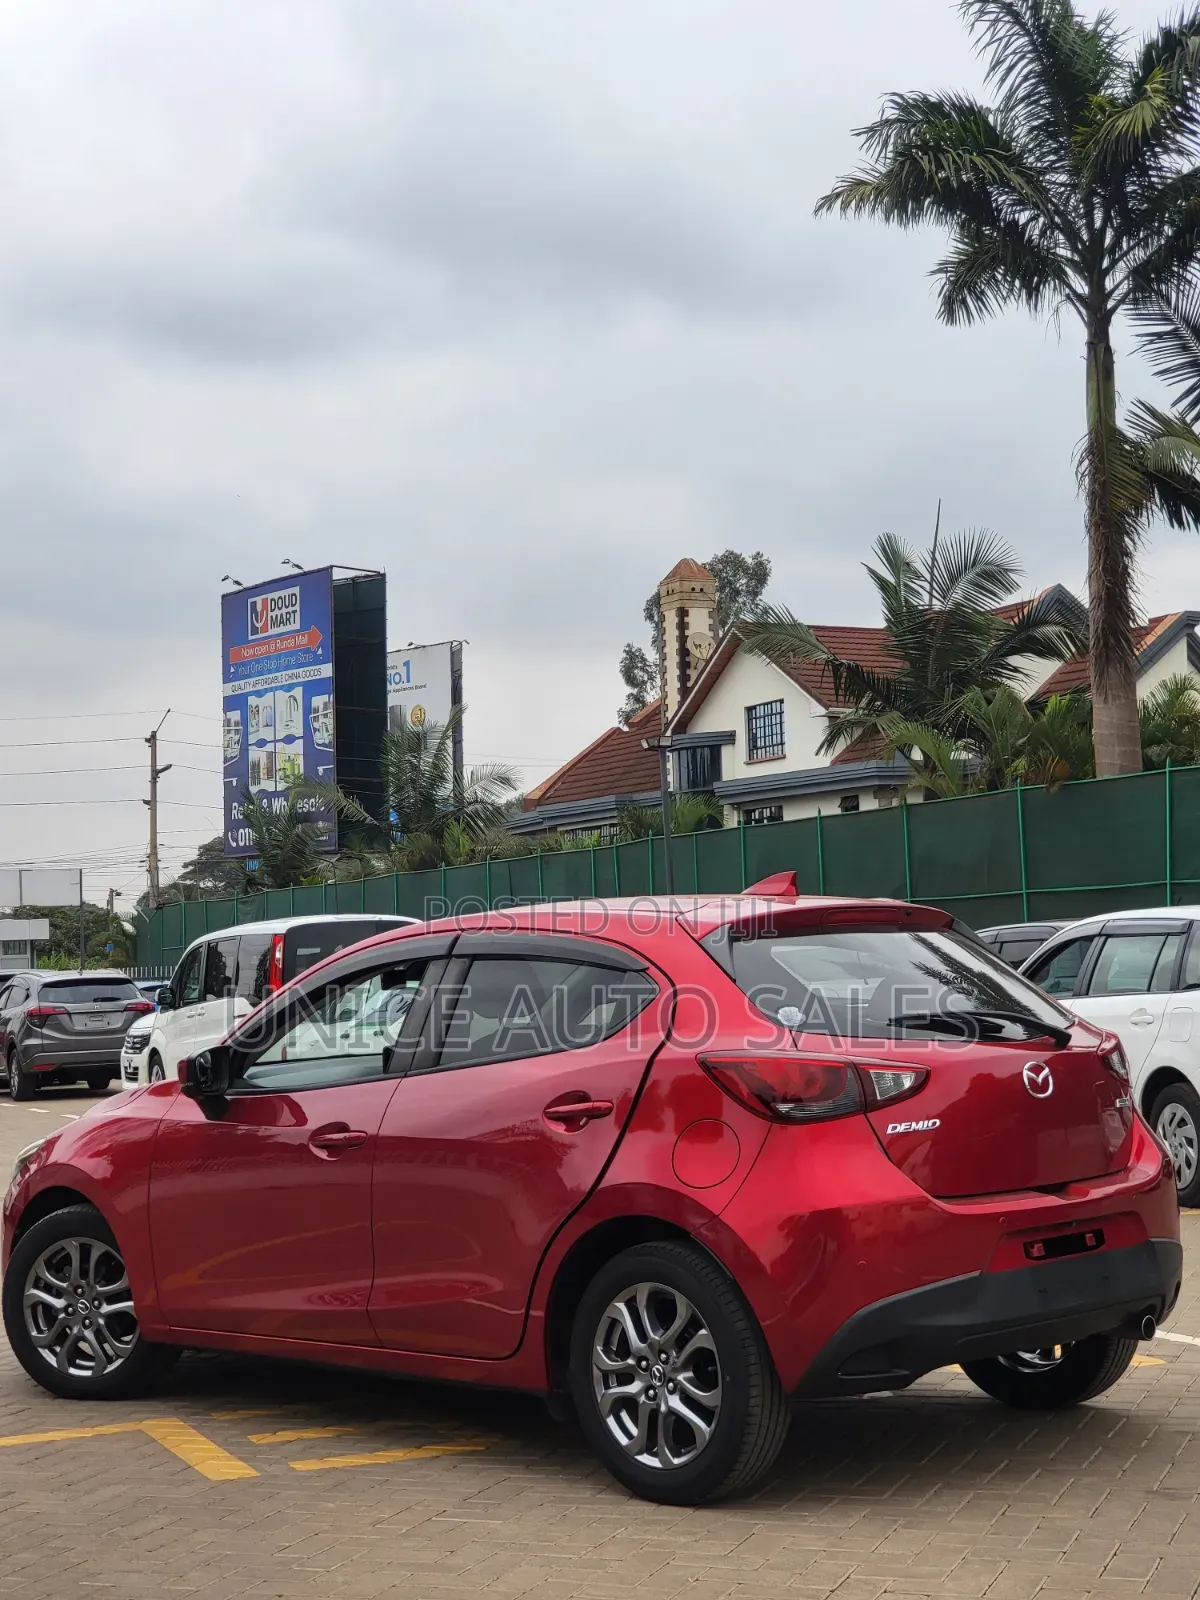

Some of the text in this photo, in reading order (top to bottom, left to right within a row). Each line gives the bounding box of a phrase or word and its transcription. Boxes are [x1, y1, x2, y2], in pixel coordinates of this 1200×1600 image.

[270, 593, 297, 612] DOUD
[270, 610, 297, 630] MART
[242, 634, 308, 658] Now open @ Runda Mall
[238, 652, 314, 676] Your One Stop Home Store
[231, 668, 322, 692] QUALITY AFFORDABLE CHINA GOODS
[886, 1118, 940, 1134] DEMIO
